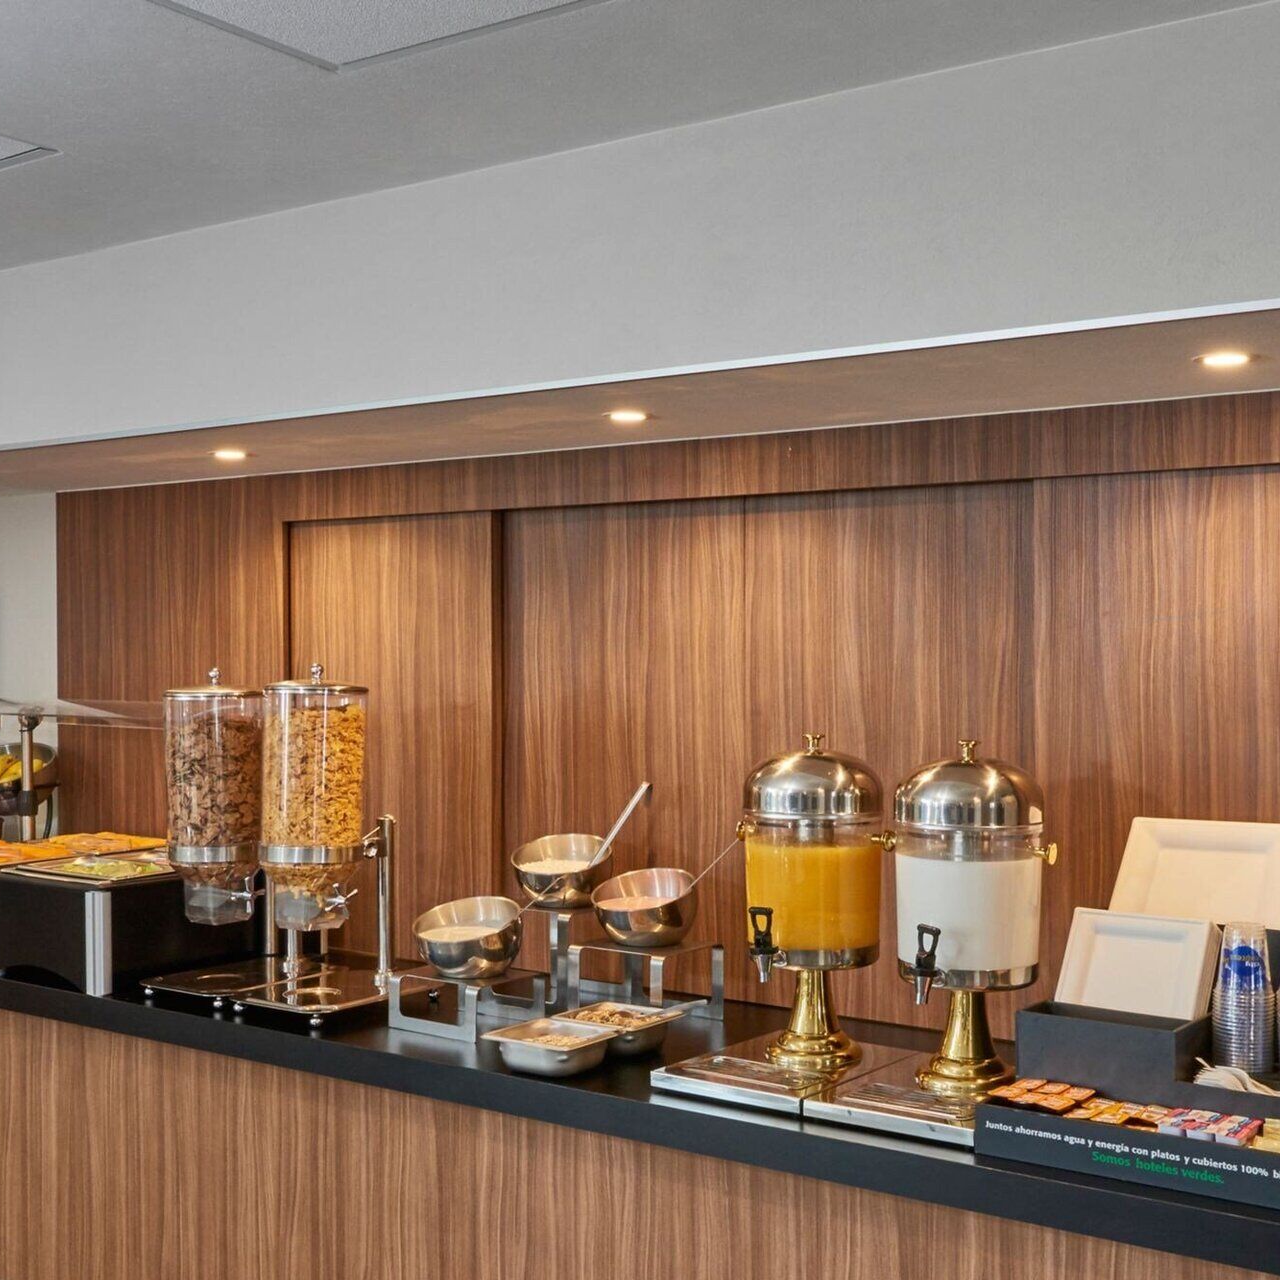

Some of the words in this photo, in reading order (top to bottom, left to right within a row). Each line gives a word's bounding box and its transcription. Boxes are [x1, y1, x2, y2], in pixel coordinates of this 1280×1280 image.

[985, 1120, 1013, 1133] Juntos
[1015, 1125, 1062, 1141] ahorramos
[1063, 1135, 1086, 1146] agua
[1087, 1139, 1094, 1148] y
[1095, 1140, 1130, 1153] energía
[1131, 1146, 1149, 1156] con
[1150, 1149, 1181, 1162] platos
[1184, 1155, 1190, 1165] y
[1192, 1156, 1238, 1172] cubiertos
[1241, 1164, 1269, 1177] 100%
[1091, 1151, 1131, 1167] Somos
[1136, 1157, 1178, 1176] hoteles
[1183, 1168, 1225, 1184] verdes.
